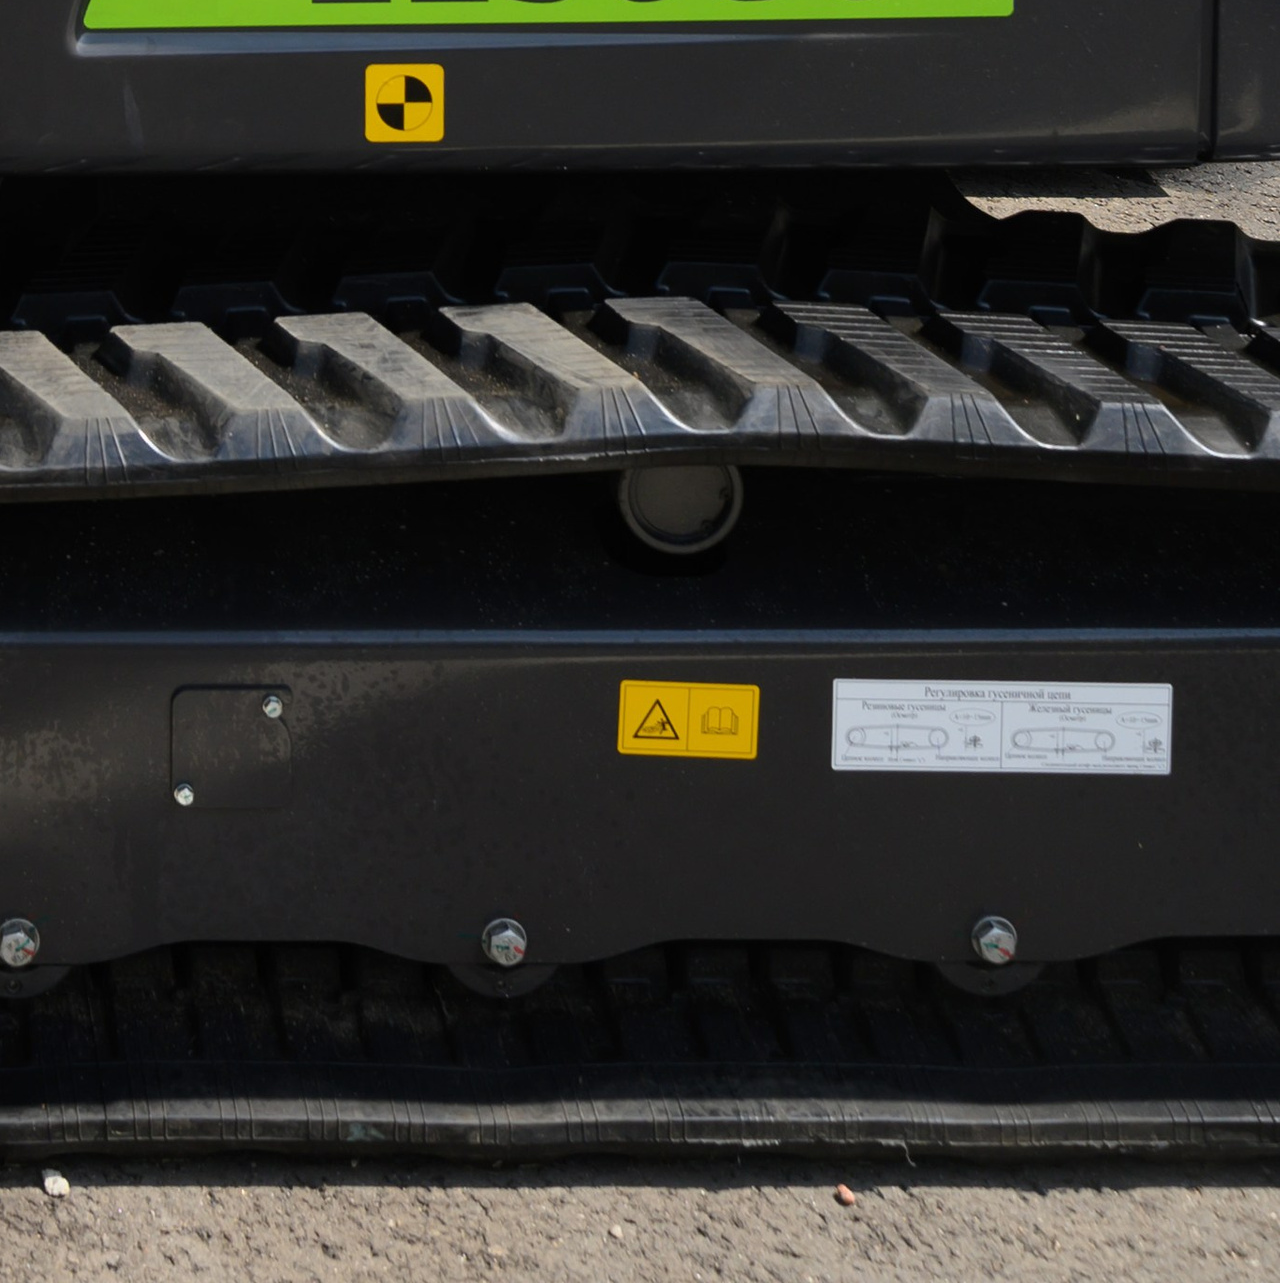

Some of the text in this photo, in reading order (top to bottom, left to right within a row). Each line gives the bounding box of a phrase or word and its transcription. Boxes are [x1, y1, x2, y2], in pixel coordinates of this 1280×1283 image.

[924, 686, 1072, 702] Регулировка гусеничной цепи
